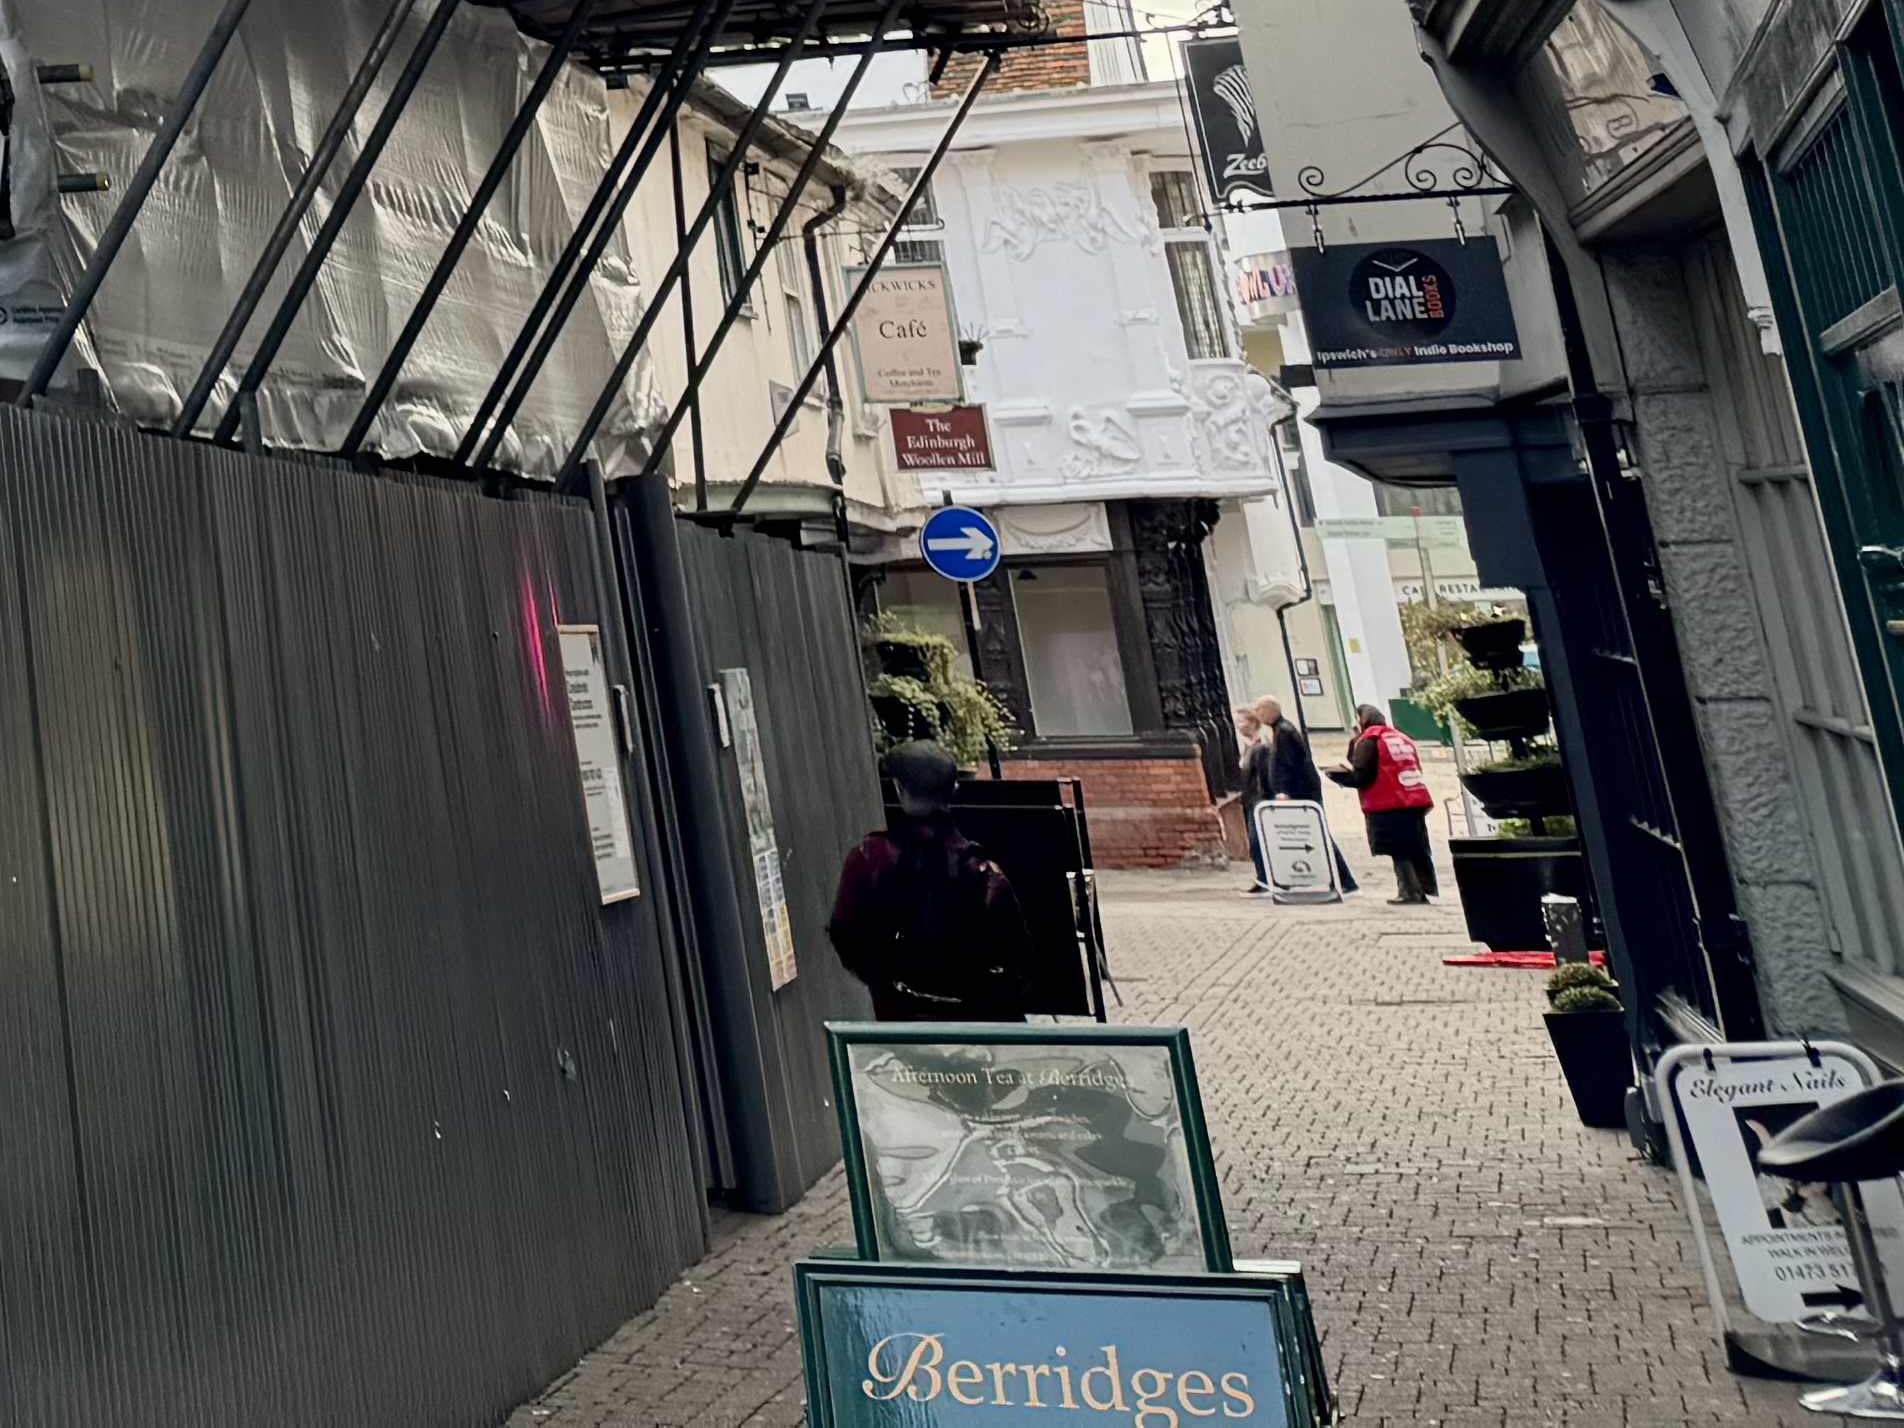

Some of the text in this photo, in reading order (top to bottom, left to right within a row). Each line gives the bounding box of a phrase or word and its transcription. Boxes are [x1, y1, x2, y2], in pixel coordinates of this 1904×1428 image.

[866, 279, 936, 293] ICKWICKS
[1368, 274, 1424, 300] DIAL
[1422, 274, 1445, 320] BOOKS
[1365, 296, 1428, 322] LANE
[879, 319, 928, 340] Café
[1317, 348, 1377, 363] Ipswich's
[1448, 342, 1513, 355] Bookshop
[925, 418, 952, 433] The
[906, 435, 975, 451] Edinburgh
[902, 451, 986, 467] Woollen Mill
[891, 1067, 978, 1084] Afternoon
[981, 1067, 1014, 1084] Tea
[1690, 1068, 1845, 1104] Elegant Nails
[1775, 1262, 1825, 1281] 01473
[862, 1332, 1256, 1428] Berridges
